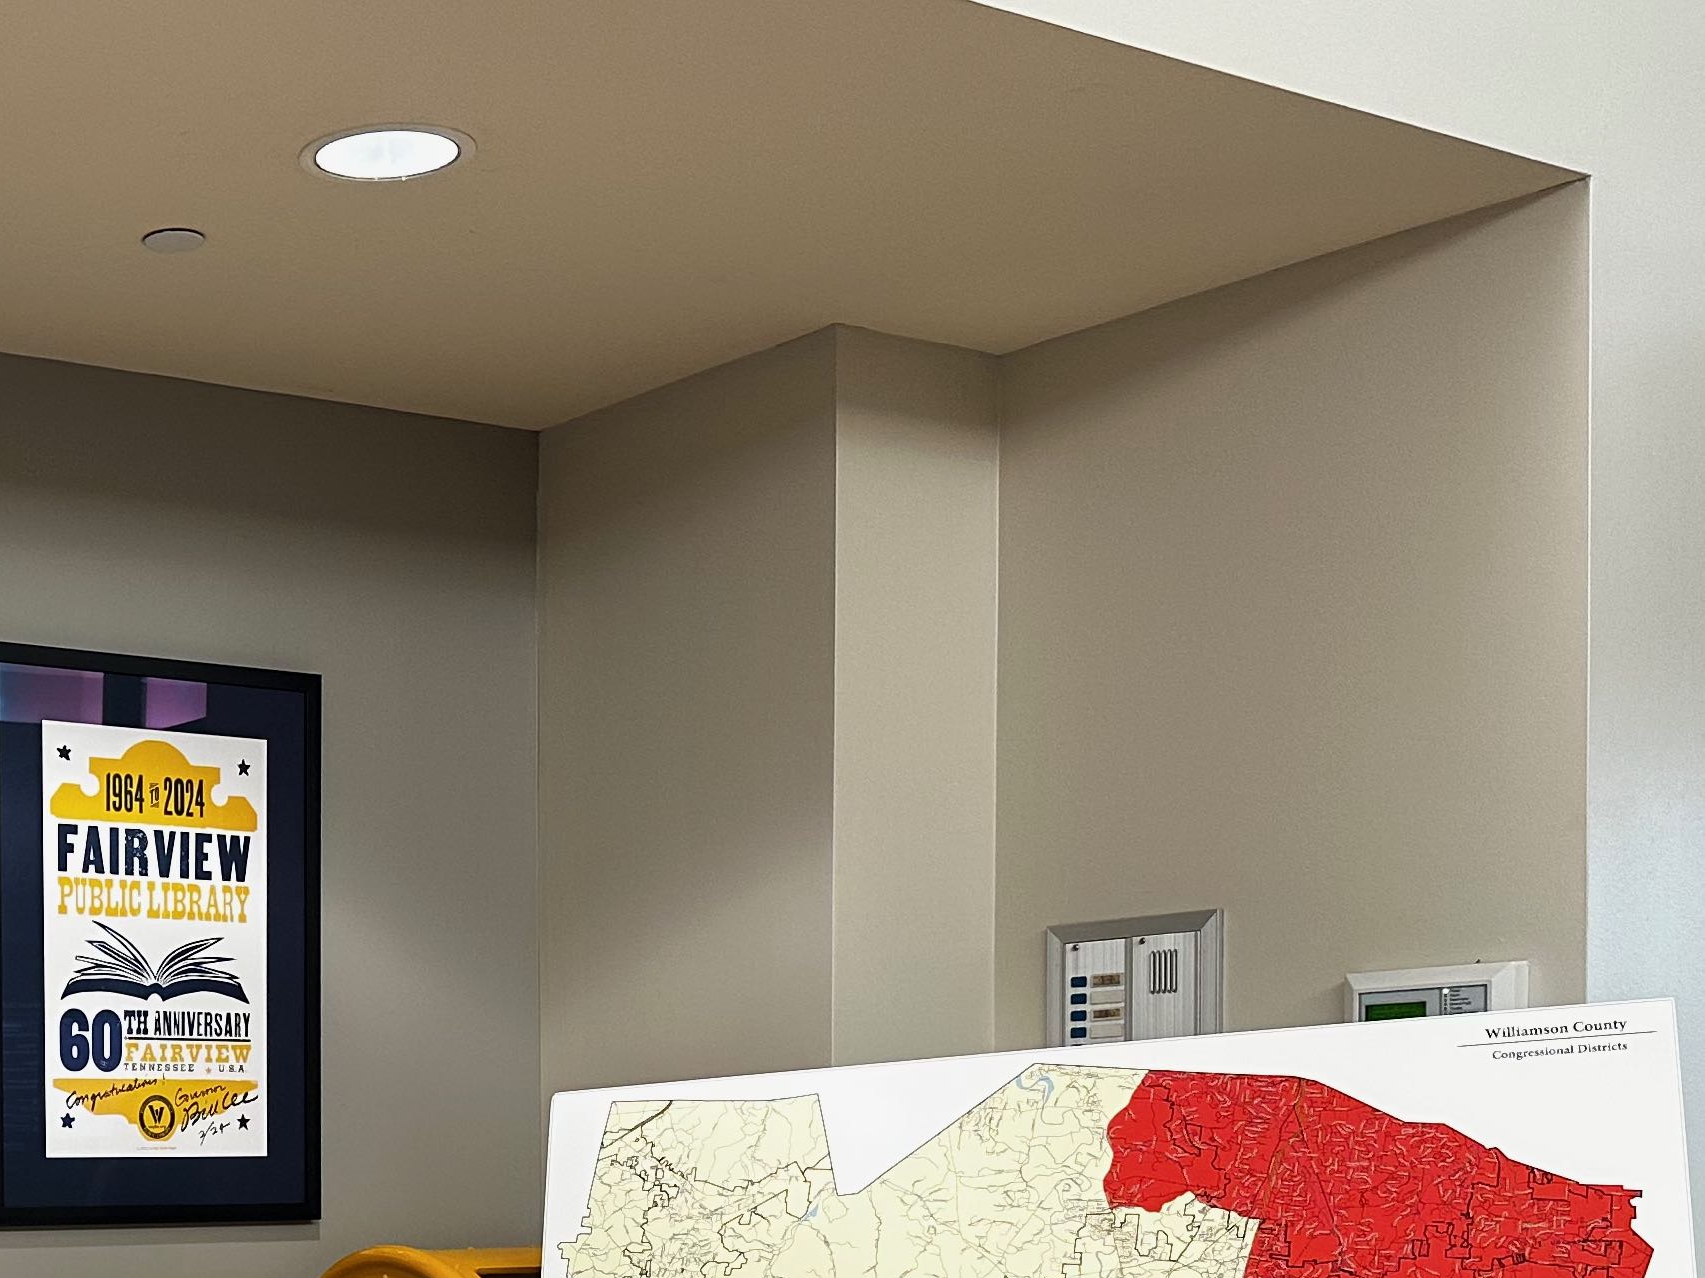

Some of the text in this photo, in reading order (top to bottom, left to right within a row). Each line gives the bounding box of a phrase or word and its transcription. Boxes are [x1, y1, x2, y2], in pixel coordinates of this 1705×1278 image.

[105, 772, 145, 814] 1964
[163, 776, 205, 818] 2024
[57, 823, 251, 883] FAIRVIEW
[57, 876, 250, 923] PUBLIC LIBRARY
[154, 1010, 251, 1038] ANNIVERSARY
[1485, 1019, 1628, 1039] Williamson County
[124, 1043, 252, 1064] FAIRVIEW
[1492, 1042, 1628, 1061] Congressional Districts
[124, 1063, 195, 1072] TENNESSEE
